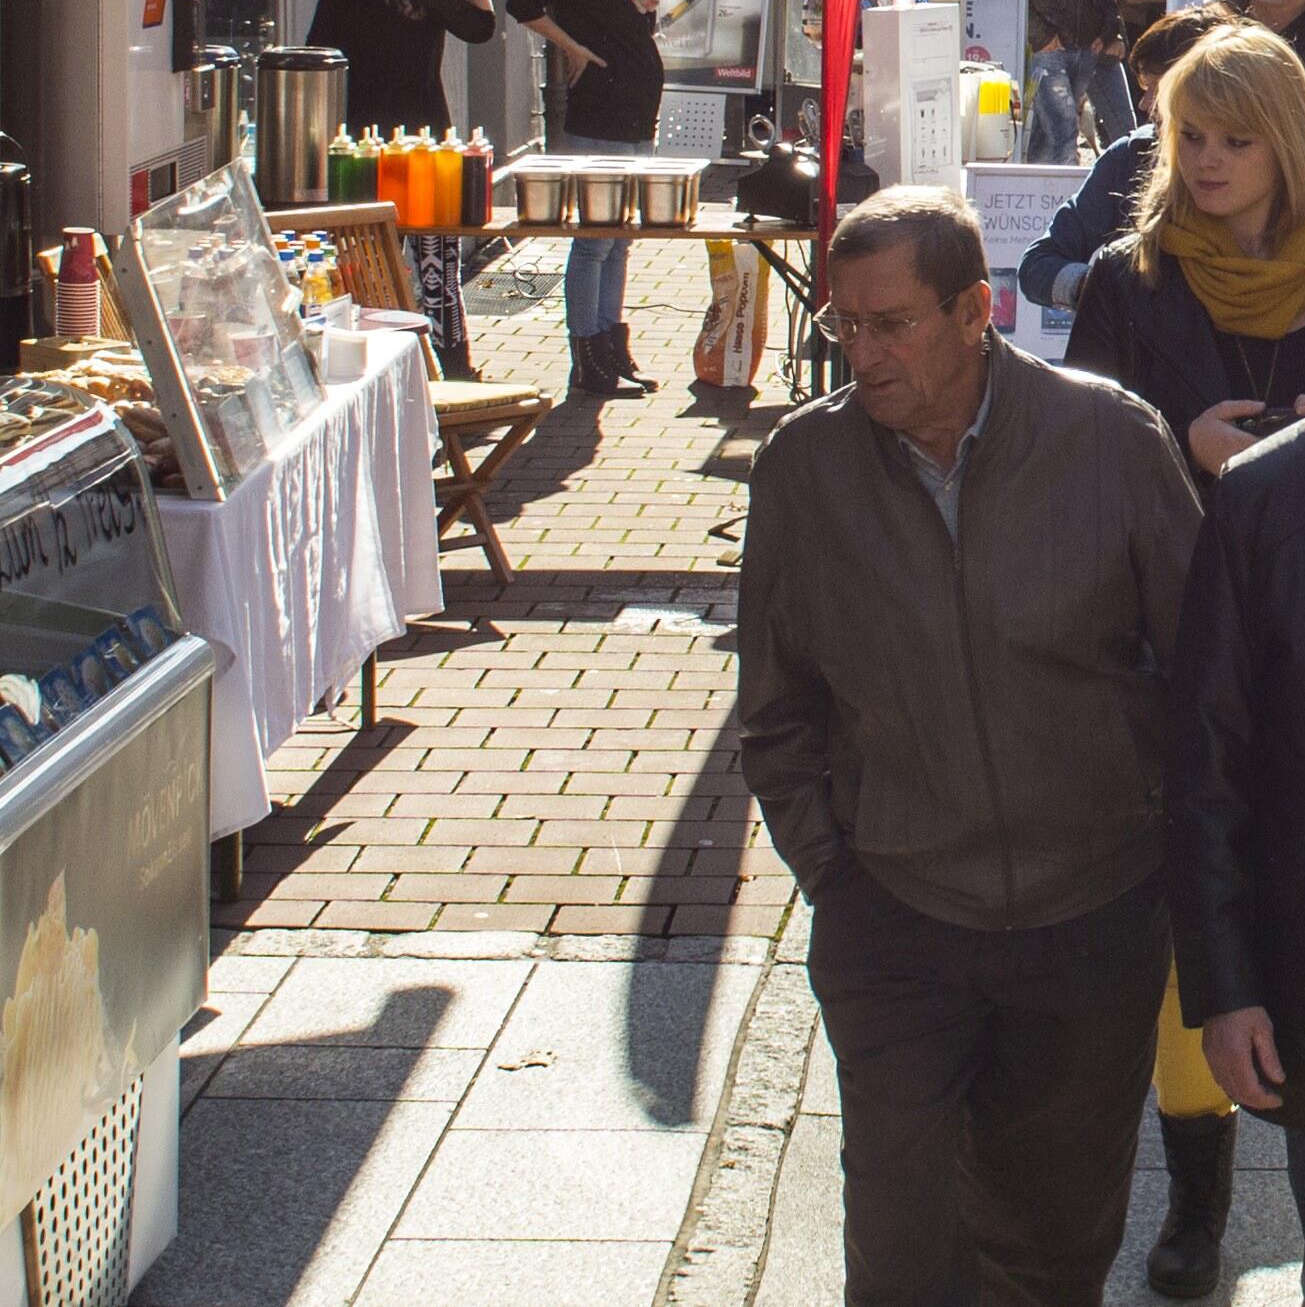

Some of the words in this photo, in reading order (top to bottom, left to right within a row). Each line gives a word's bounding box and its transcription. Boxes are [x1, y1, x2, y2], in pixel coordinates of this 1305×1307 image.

[717, 68, 751, 78] Weltbild
[984, 194, 1033, 209] JETZT
[1040, 195, 1072, 209] SM
[736, 271, 750, 319] Popcorn
